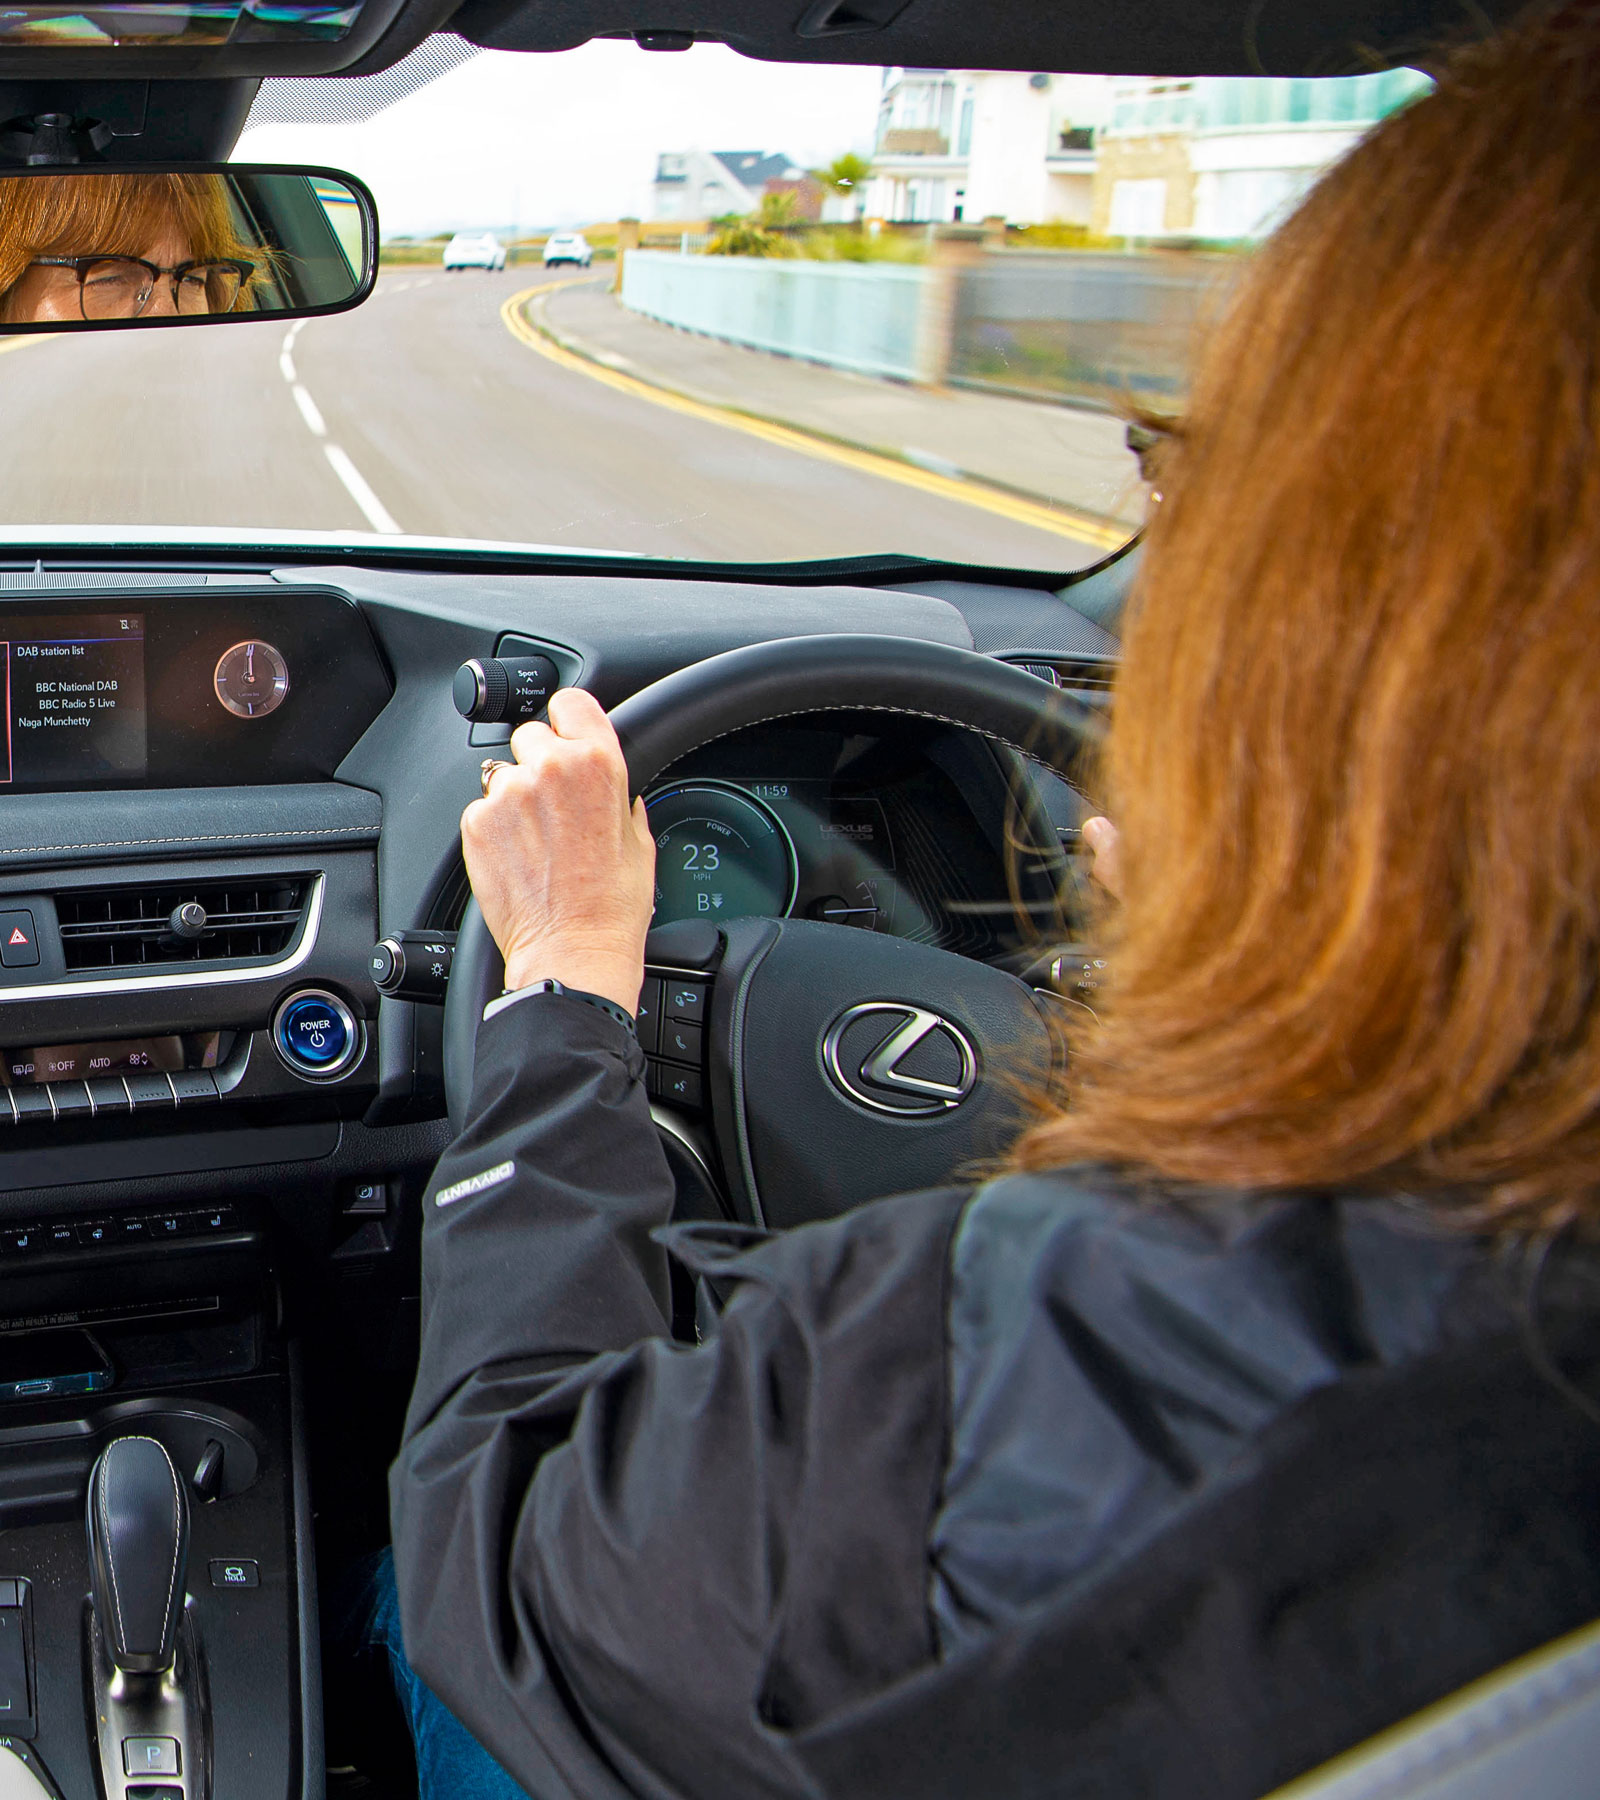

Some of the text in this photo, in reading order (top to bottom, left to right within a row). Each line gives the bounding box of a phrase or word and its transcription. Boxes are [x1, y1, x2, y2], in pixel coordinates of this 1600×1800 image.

[17, 644, 84, 658] DAB station list
[518, 670, 538, 678] Sport
[36, 680, 118, 693] BBC National DAB
[522, 688, 546, 696] Normal
[39, 698, 116, 710] BBC Radio 5 Live
[18, 715, 91, 729] Naga Munchetty
[754, 786, 788, 796] 11:59
[706, 822, 730, 838] POWER
[819, 824, 874, 833] LEXUS
[658, 834, 670, 848] ECO
[682, 844, 720, 871] 23
[697, 894, 710, 912] B
[300, 1020, 330, 1031] POWER
[56, 1060, 75, 1071] OFF
[90, 1058, 110, 1068] AUTO
[26, 1317, 48, 1327] RESULT
[50, 1316, 56, 1324] IN
[58, 1314, 78, 1323] BURNS
[224, 1574, 246, 1582] HOLD
[146, 1746, 160, 1765] P
